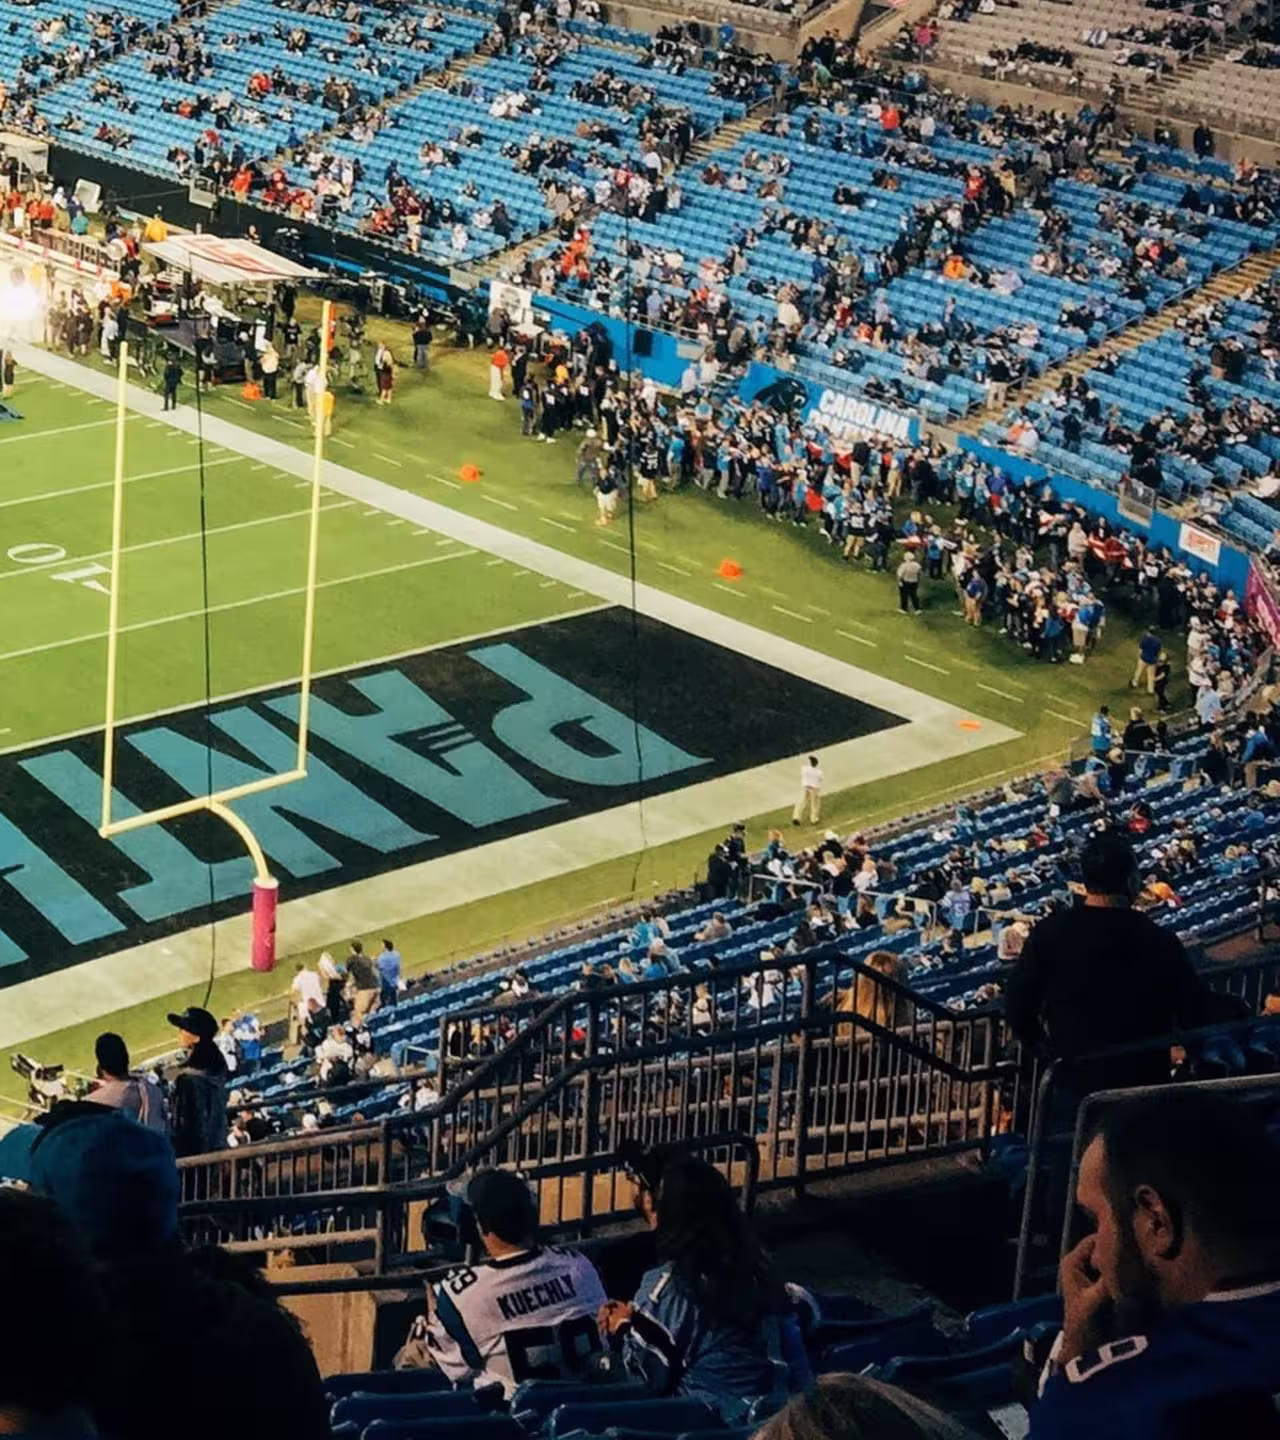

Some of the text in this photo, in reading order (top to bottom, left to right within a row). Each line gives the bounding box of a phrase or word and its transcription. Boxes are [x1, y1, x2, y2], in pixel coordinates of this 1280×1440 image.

[819, 389, 911, 442] CAROLINA
[6, 542, 113, 591] 10
[496, 1273, 576, 1320] KUECHLY
